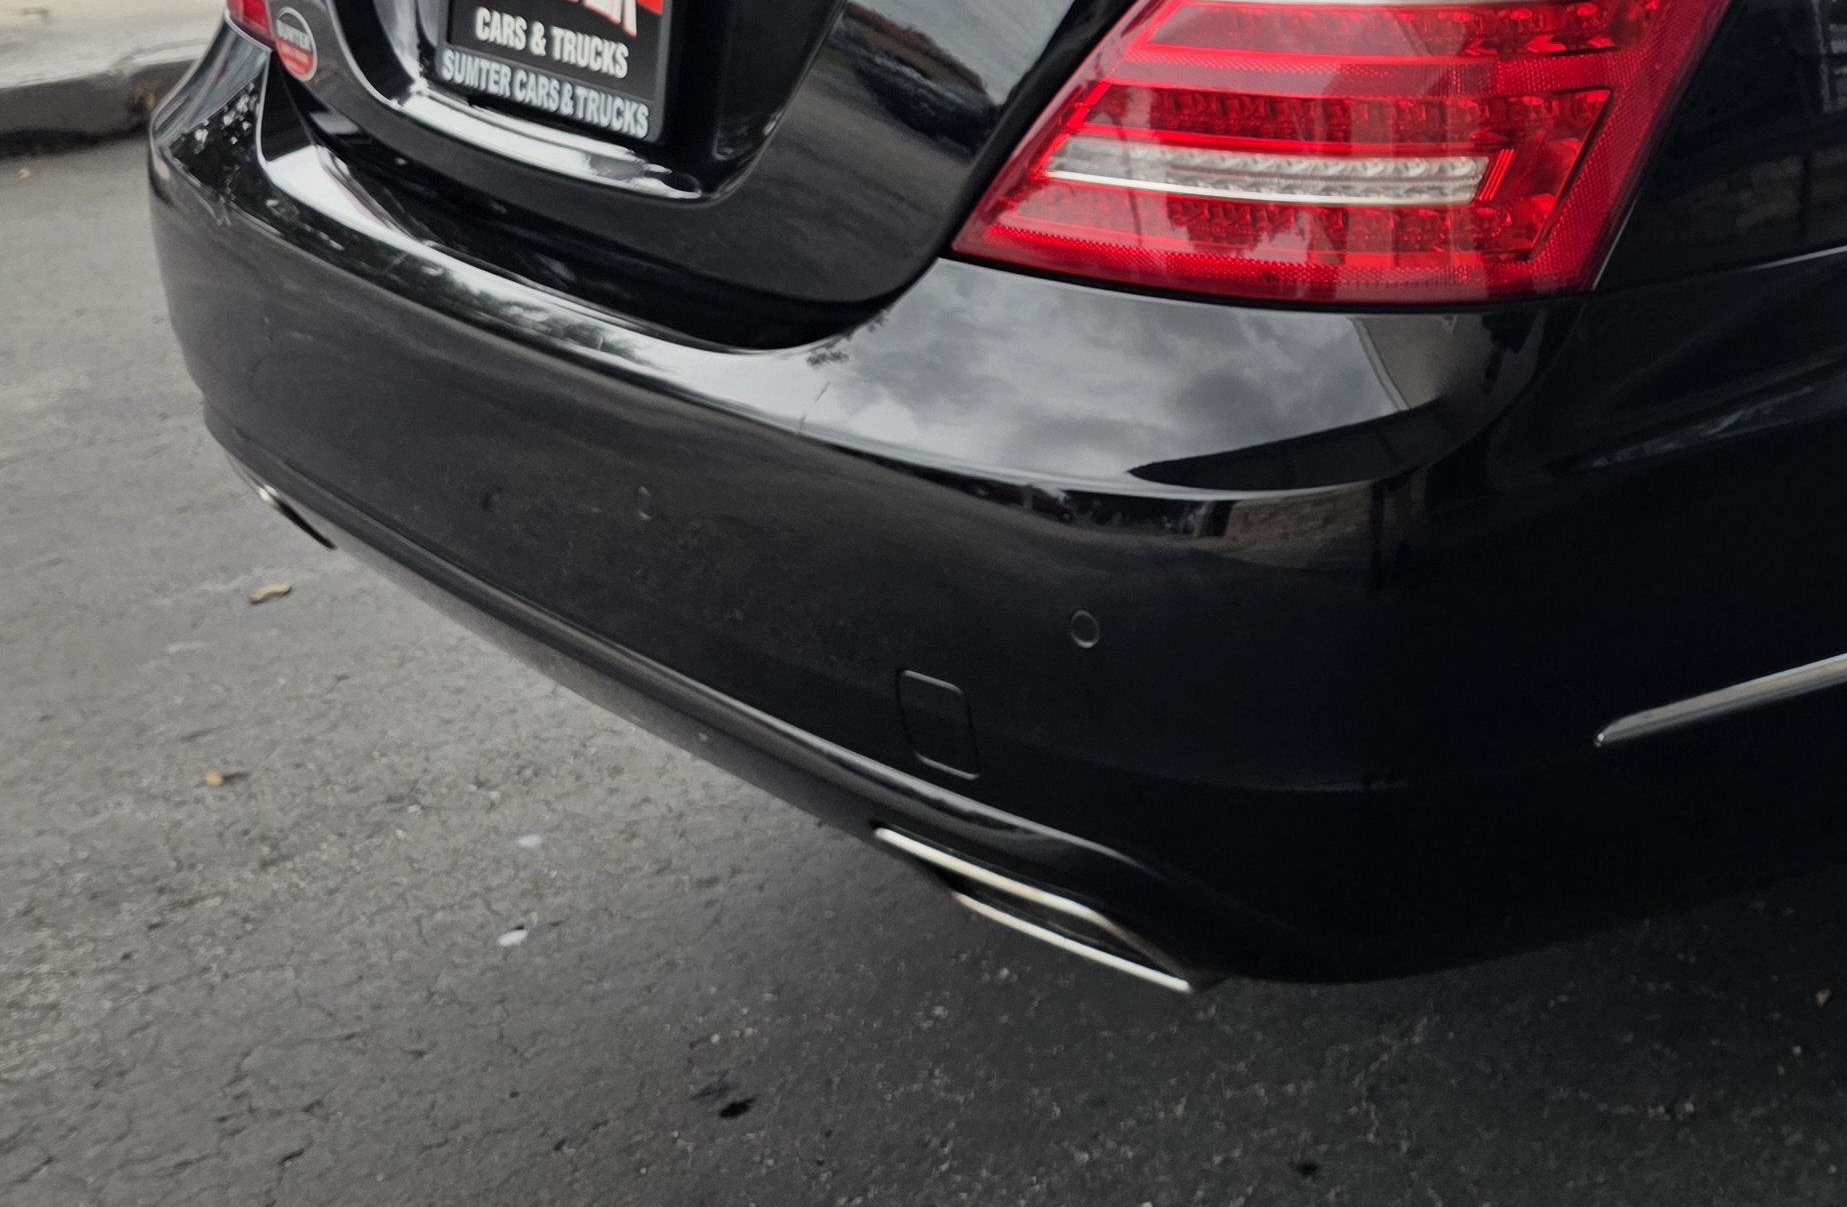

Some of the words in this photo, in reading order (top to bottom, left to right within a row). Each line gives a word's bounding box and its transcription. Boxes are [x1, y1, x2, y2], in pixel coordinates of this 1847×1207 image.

[476, 6, 528, 51] CARS
[530, 22, 546, 56] &
[552, 26, 629, 79] TRUCKS
[442, 49, 511, 98] SUMTER
[514, 69, 560, 111] CARS
[560, 82, 575, 116] &
[574, 89, 650, 139] TRUCKS
